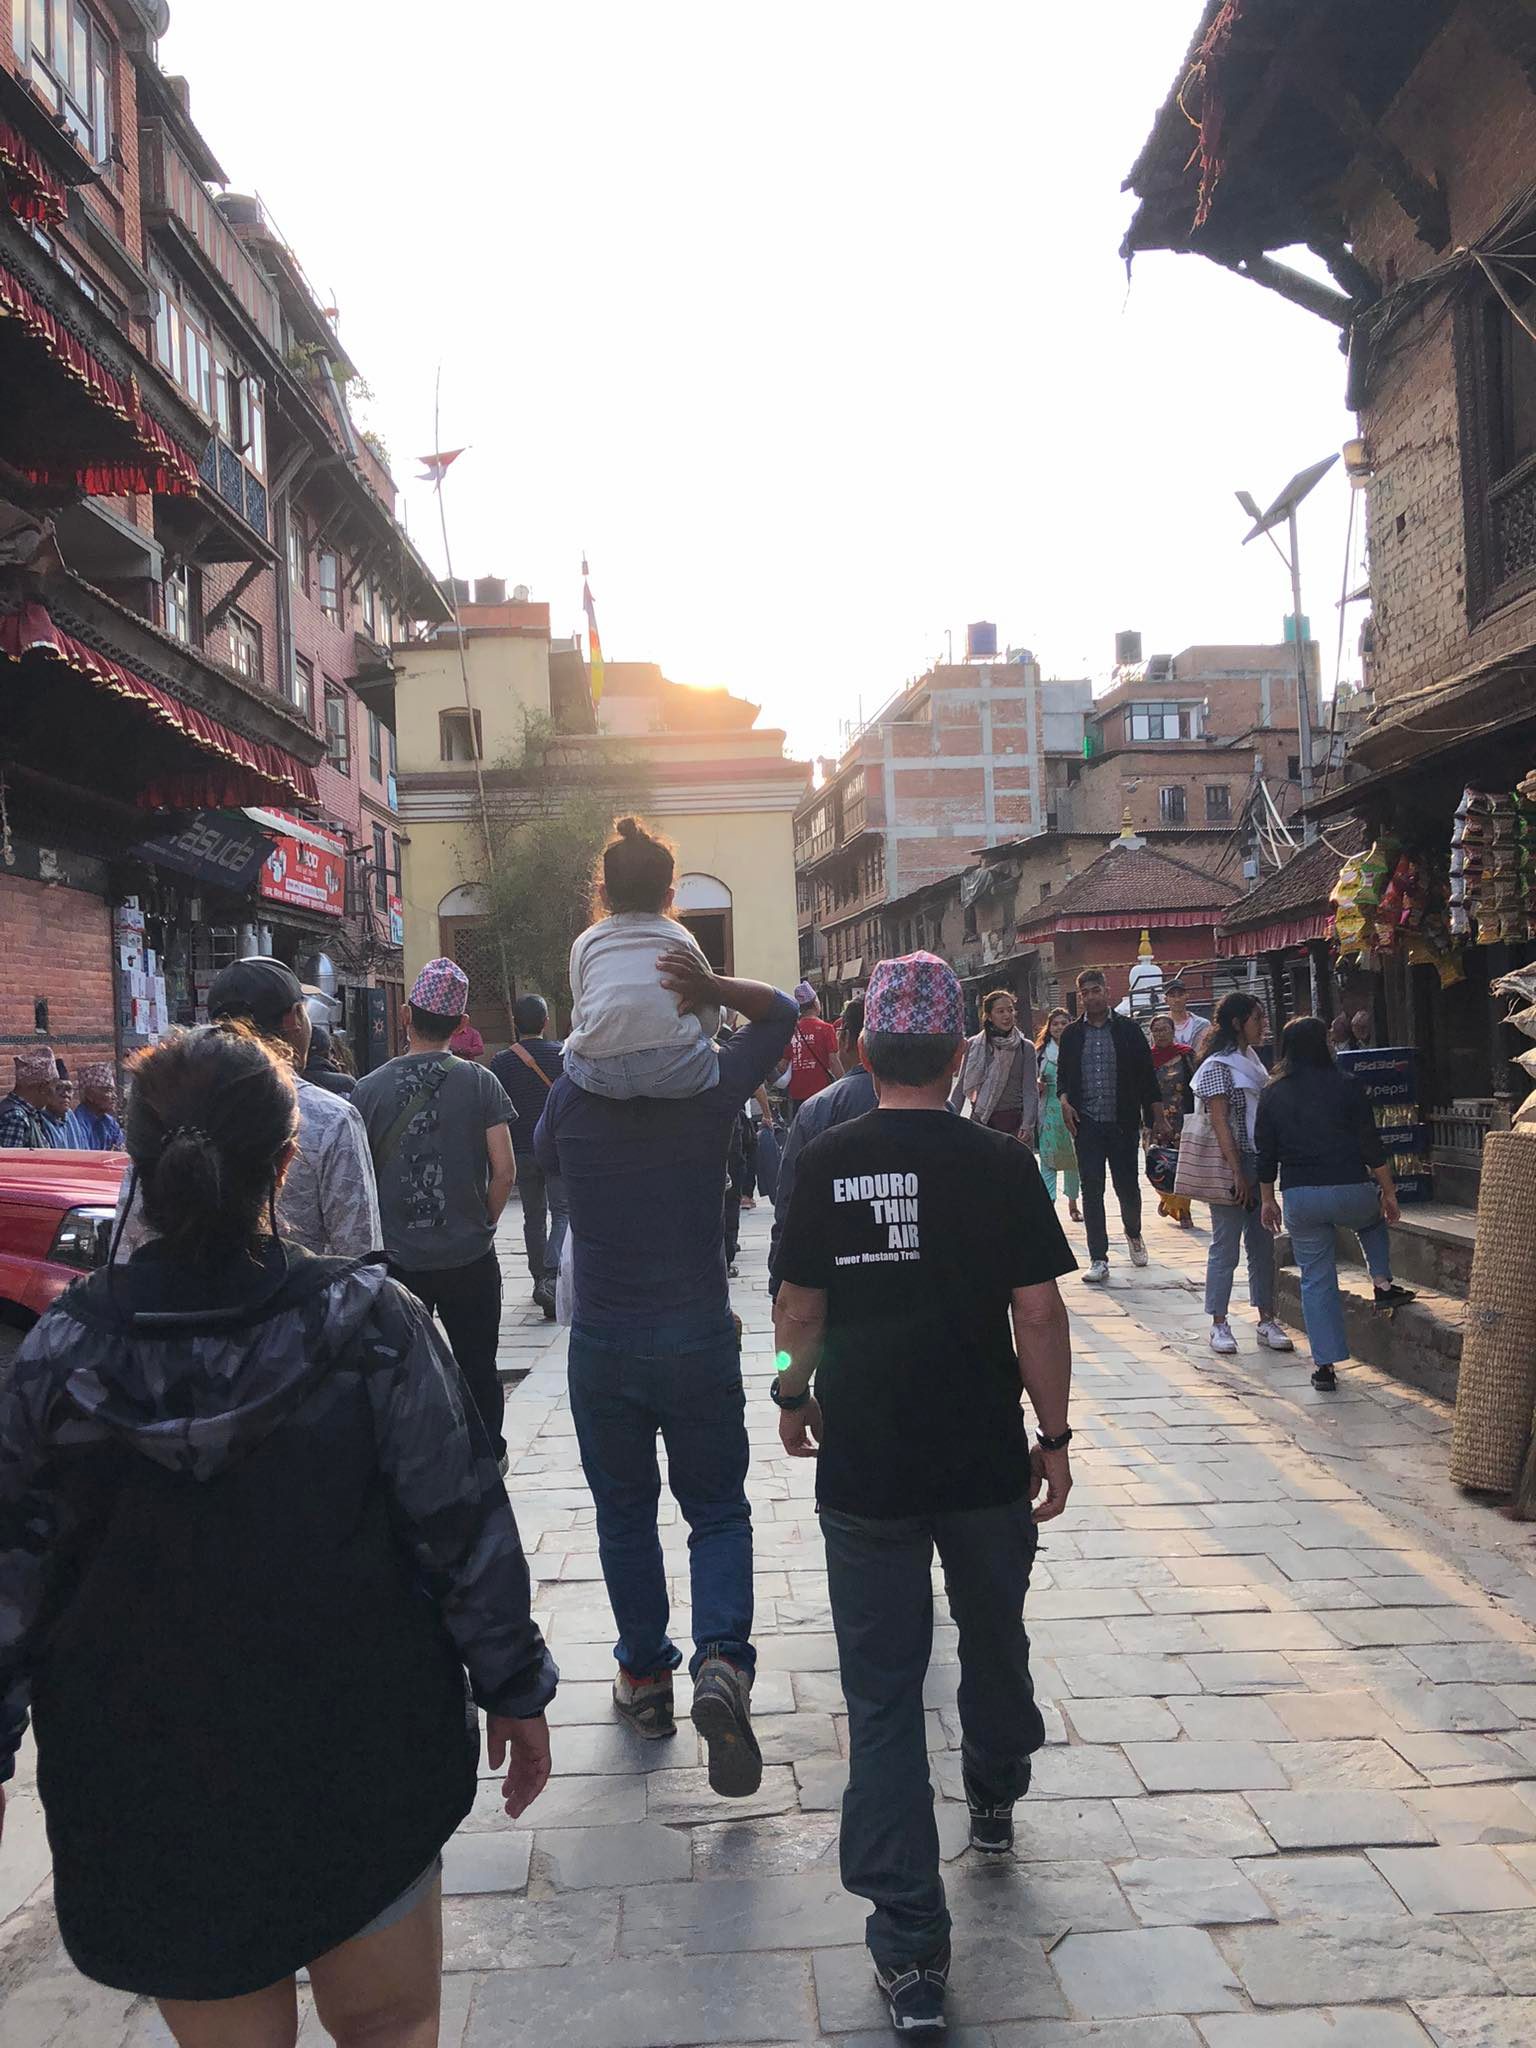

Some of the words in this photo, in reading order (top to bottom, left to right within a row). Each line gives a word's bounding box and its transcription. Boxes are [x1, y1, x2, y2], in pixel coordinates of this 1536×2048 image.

[833, 1172, 918, 1202] ENDURO
[870, 1199, 918, 1224] THIN
[888, 1224, 919, 1249] AIR
[835, 1255, 861, 1266] Lower
[862, 1252, 899, 1262] Mustang
